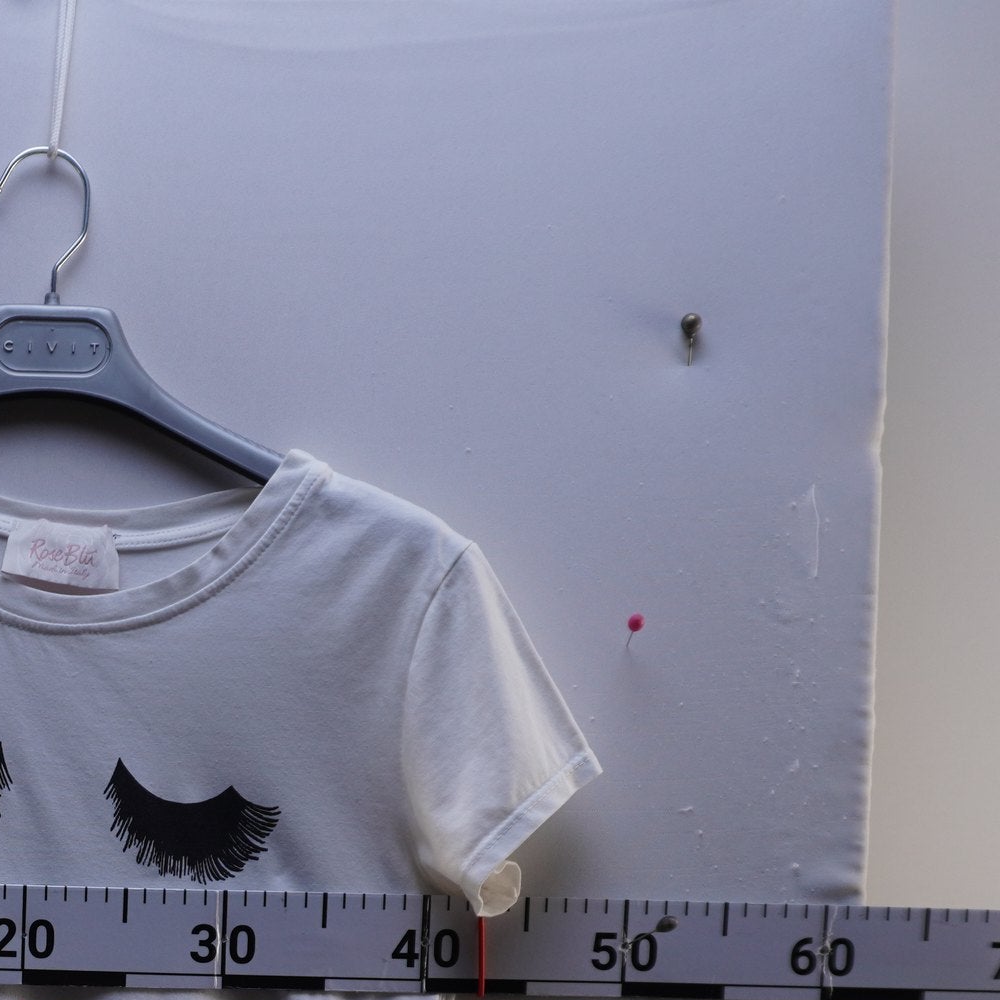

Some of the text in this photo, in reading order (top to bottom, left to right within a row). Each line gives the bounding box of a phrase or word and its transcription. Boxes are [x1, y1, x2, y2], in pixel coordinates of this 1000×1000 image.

[3, 339, 100, 355] CIVIT
[189, 923, 256, 965] 30
[391, 928, 460, 968] 40
[590, 932, 658, 972] 50
[790, 937, 855, 977] 60
